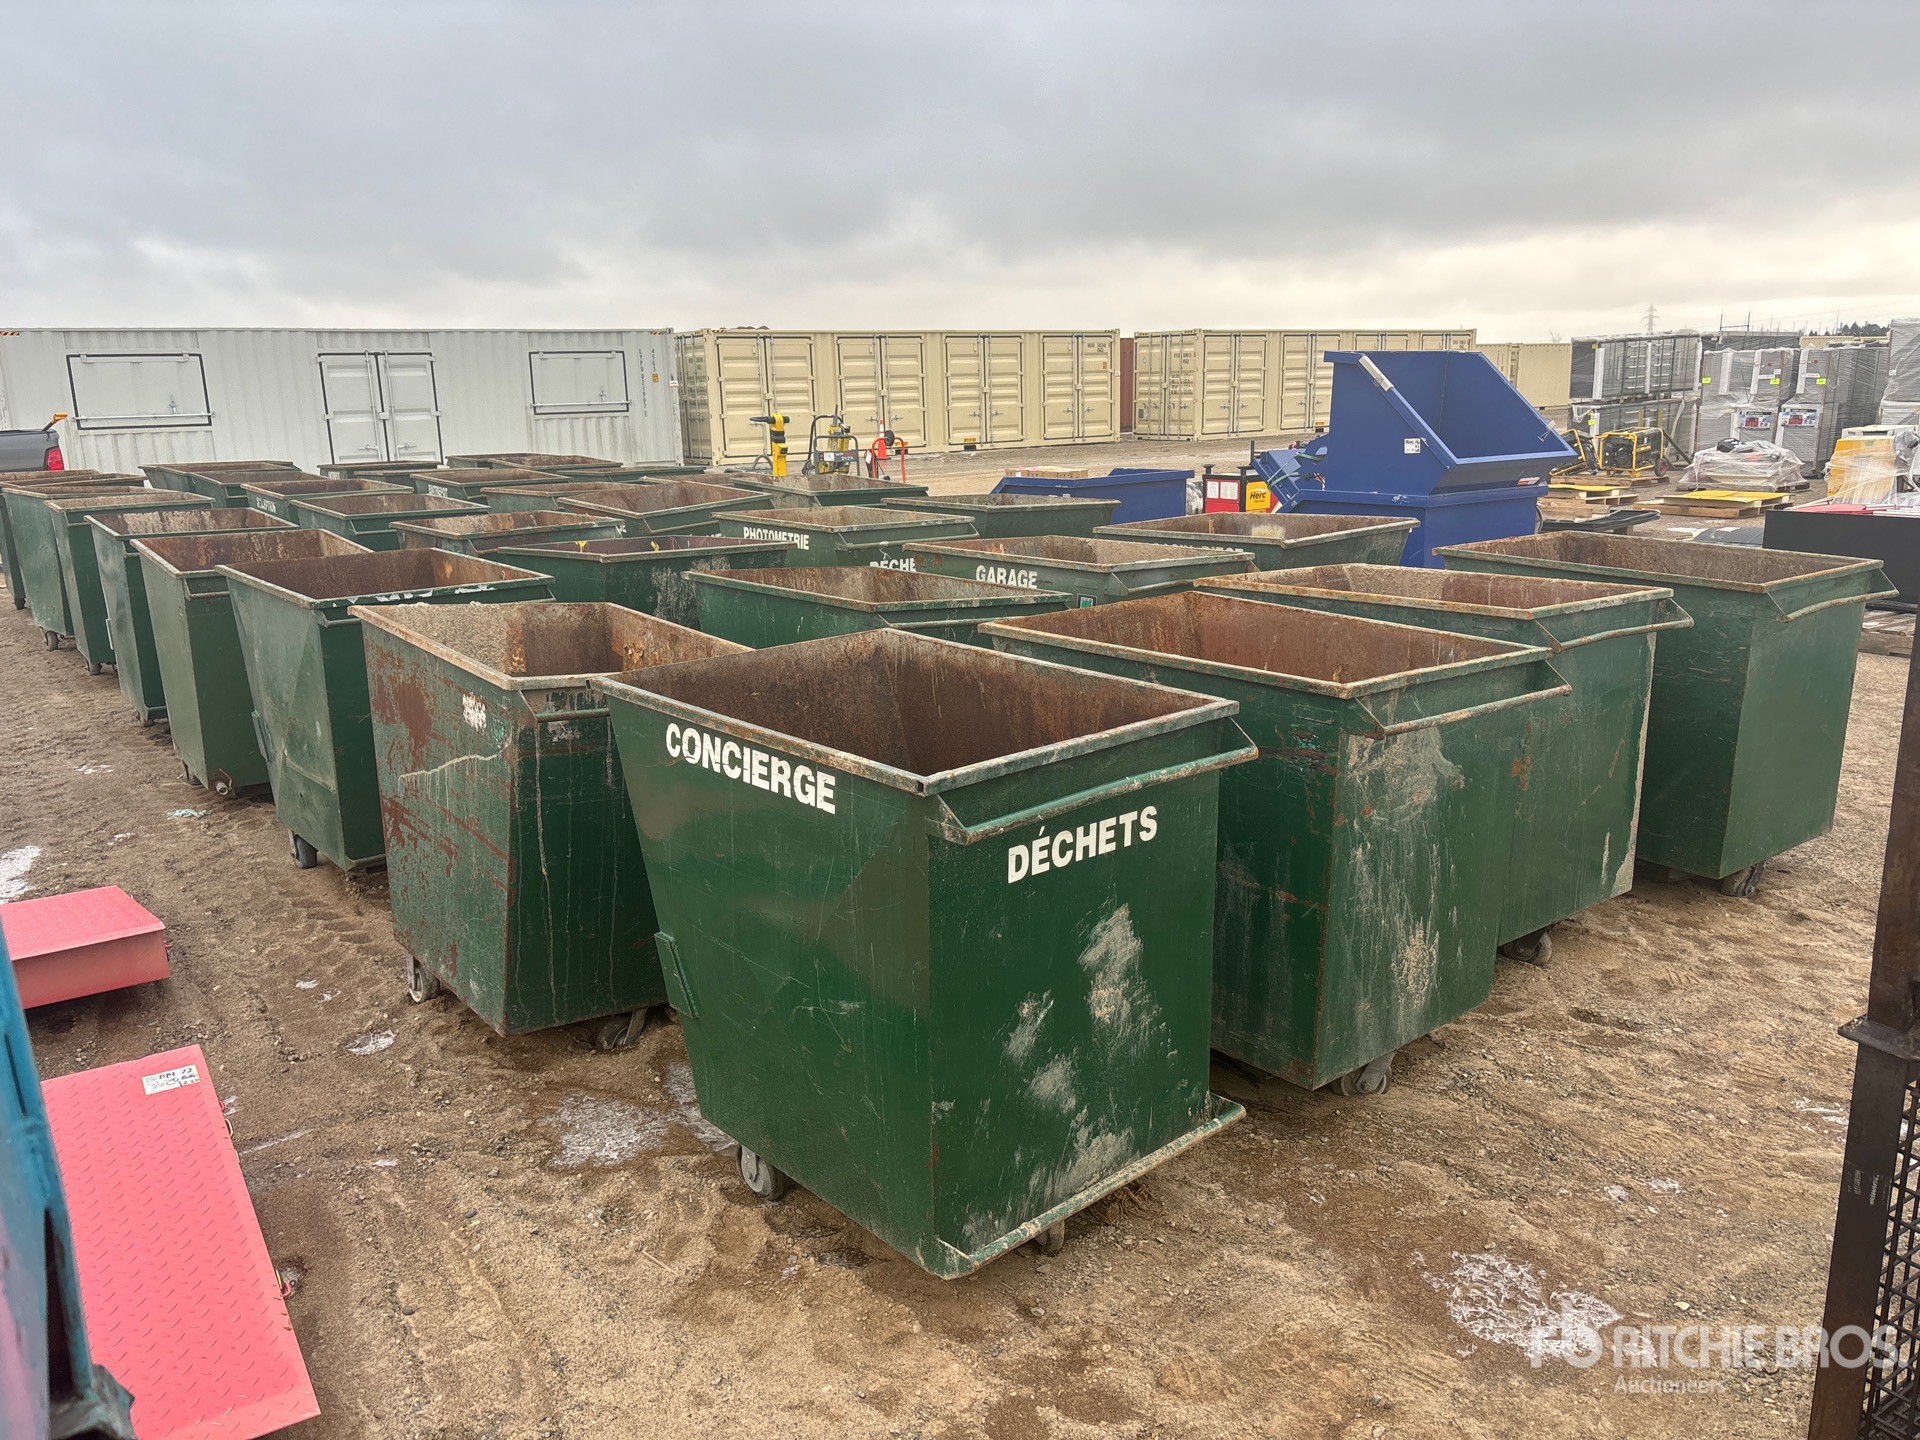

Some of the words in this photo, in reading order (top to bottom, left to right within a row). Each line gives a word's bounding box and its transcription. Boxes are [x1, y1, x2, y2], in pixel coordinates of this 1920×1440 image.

[1249, 491, 1266, 500] Herc
[975, 564, 1038, 589] GARAGE
[666, 723, 836, 815] CONCIERGE
[1008, 805, 1158, 884] DÉCHETS
